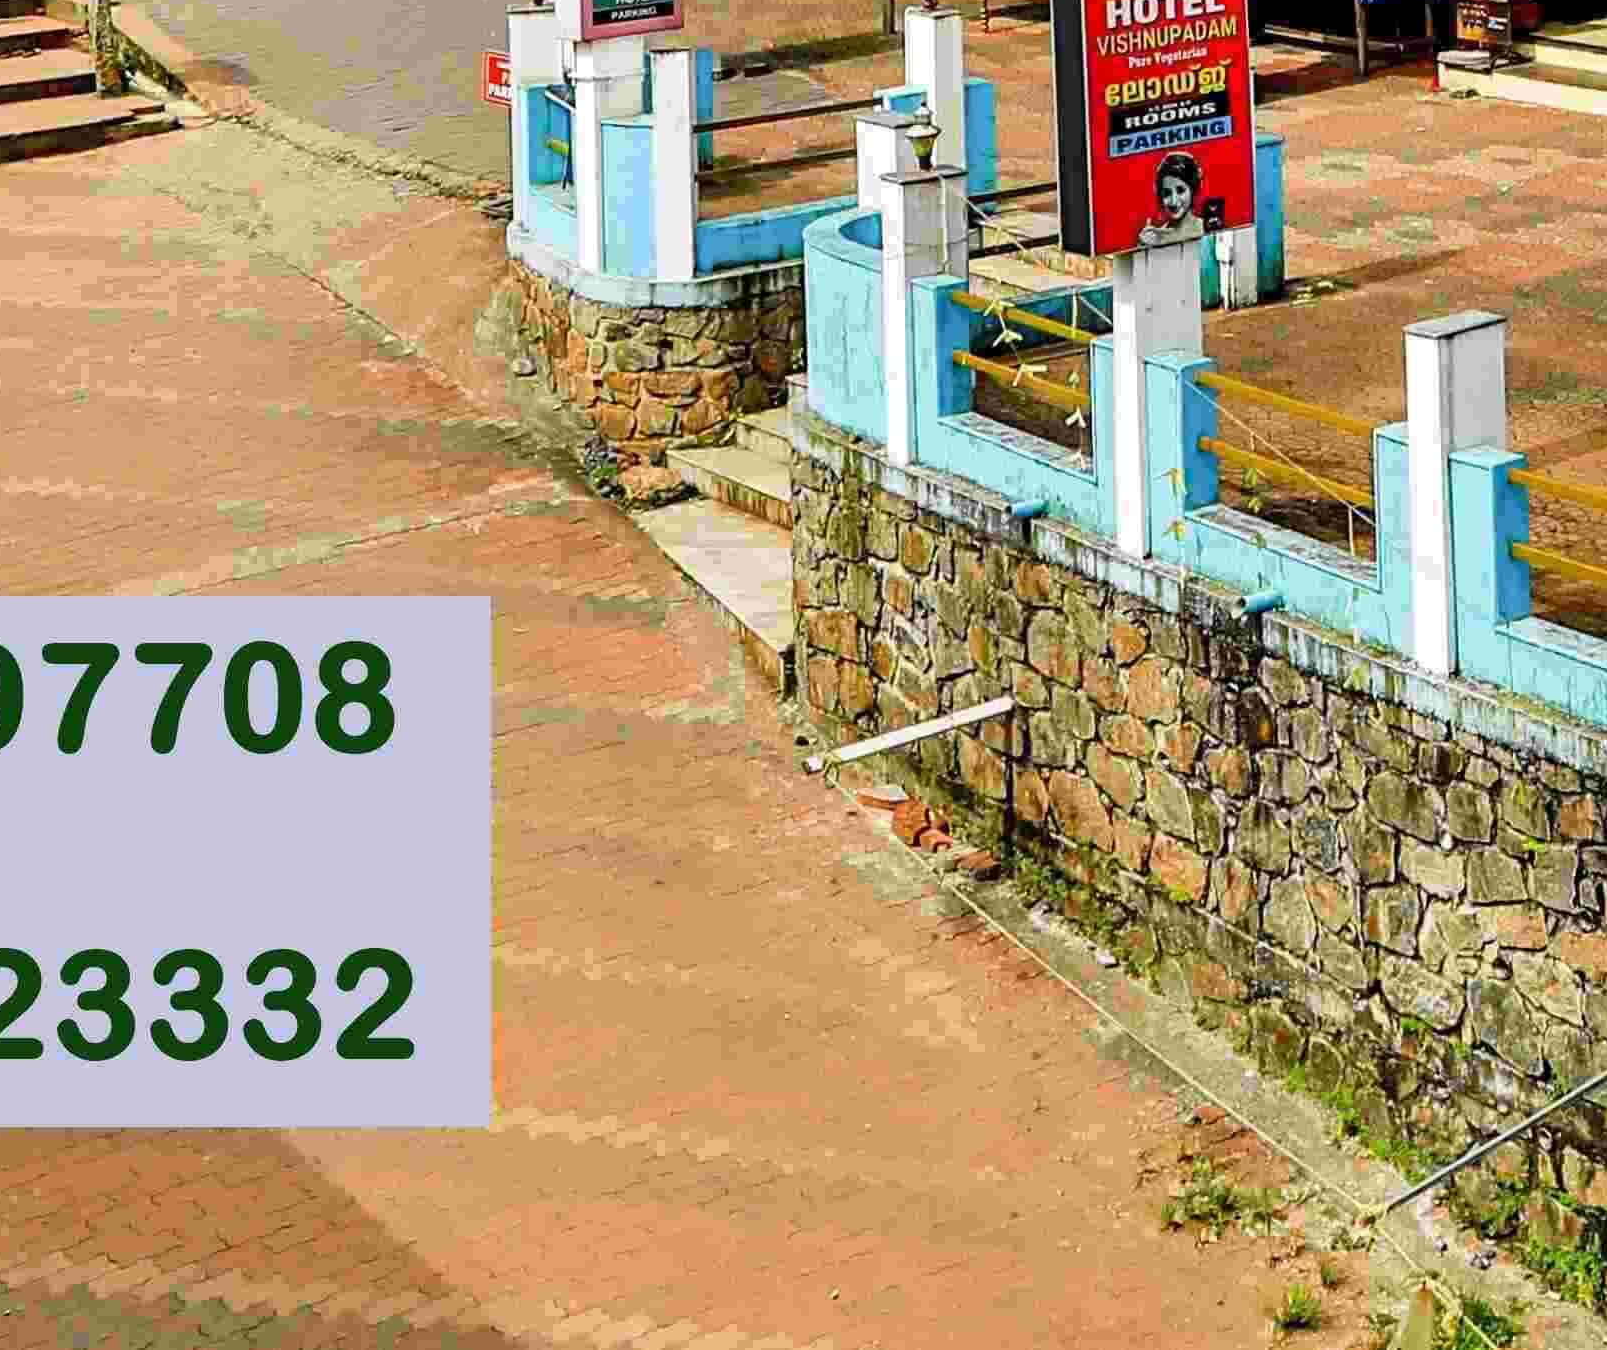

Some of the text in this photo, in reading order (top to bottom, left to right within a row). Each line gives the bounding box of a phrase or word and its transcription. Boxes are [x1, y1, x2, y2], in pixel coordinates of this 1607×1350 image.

[610, 6, 658, 20] PARKING
[1096, 15, 1237, 57] VISHNUPADAM
[1129, 47, 1208, 69] Pure Vegetarian
[1124, 100, 1217, 129] ROOMS
[1116, 120, 1227, 154] PARKING
